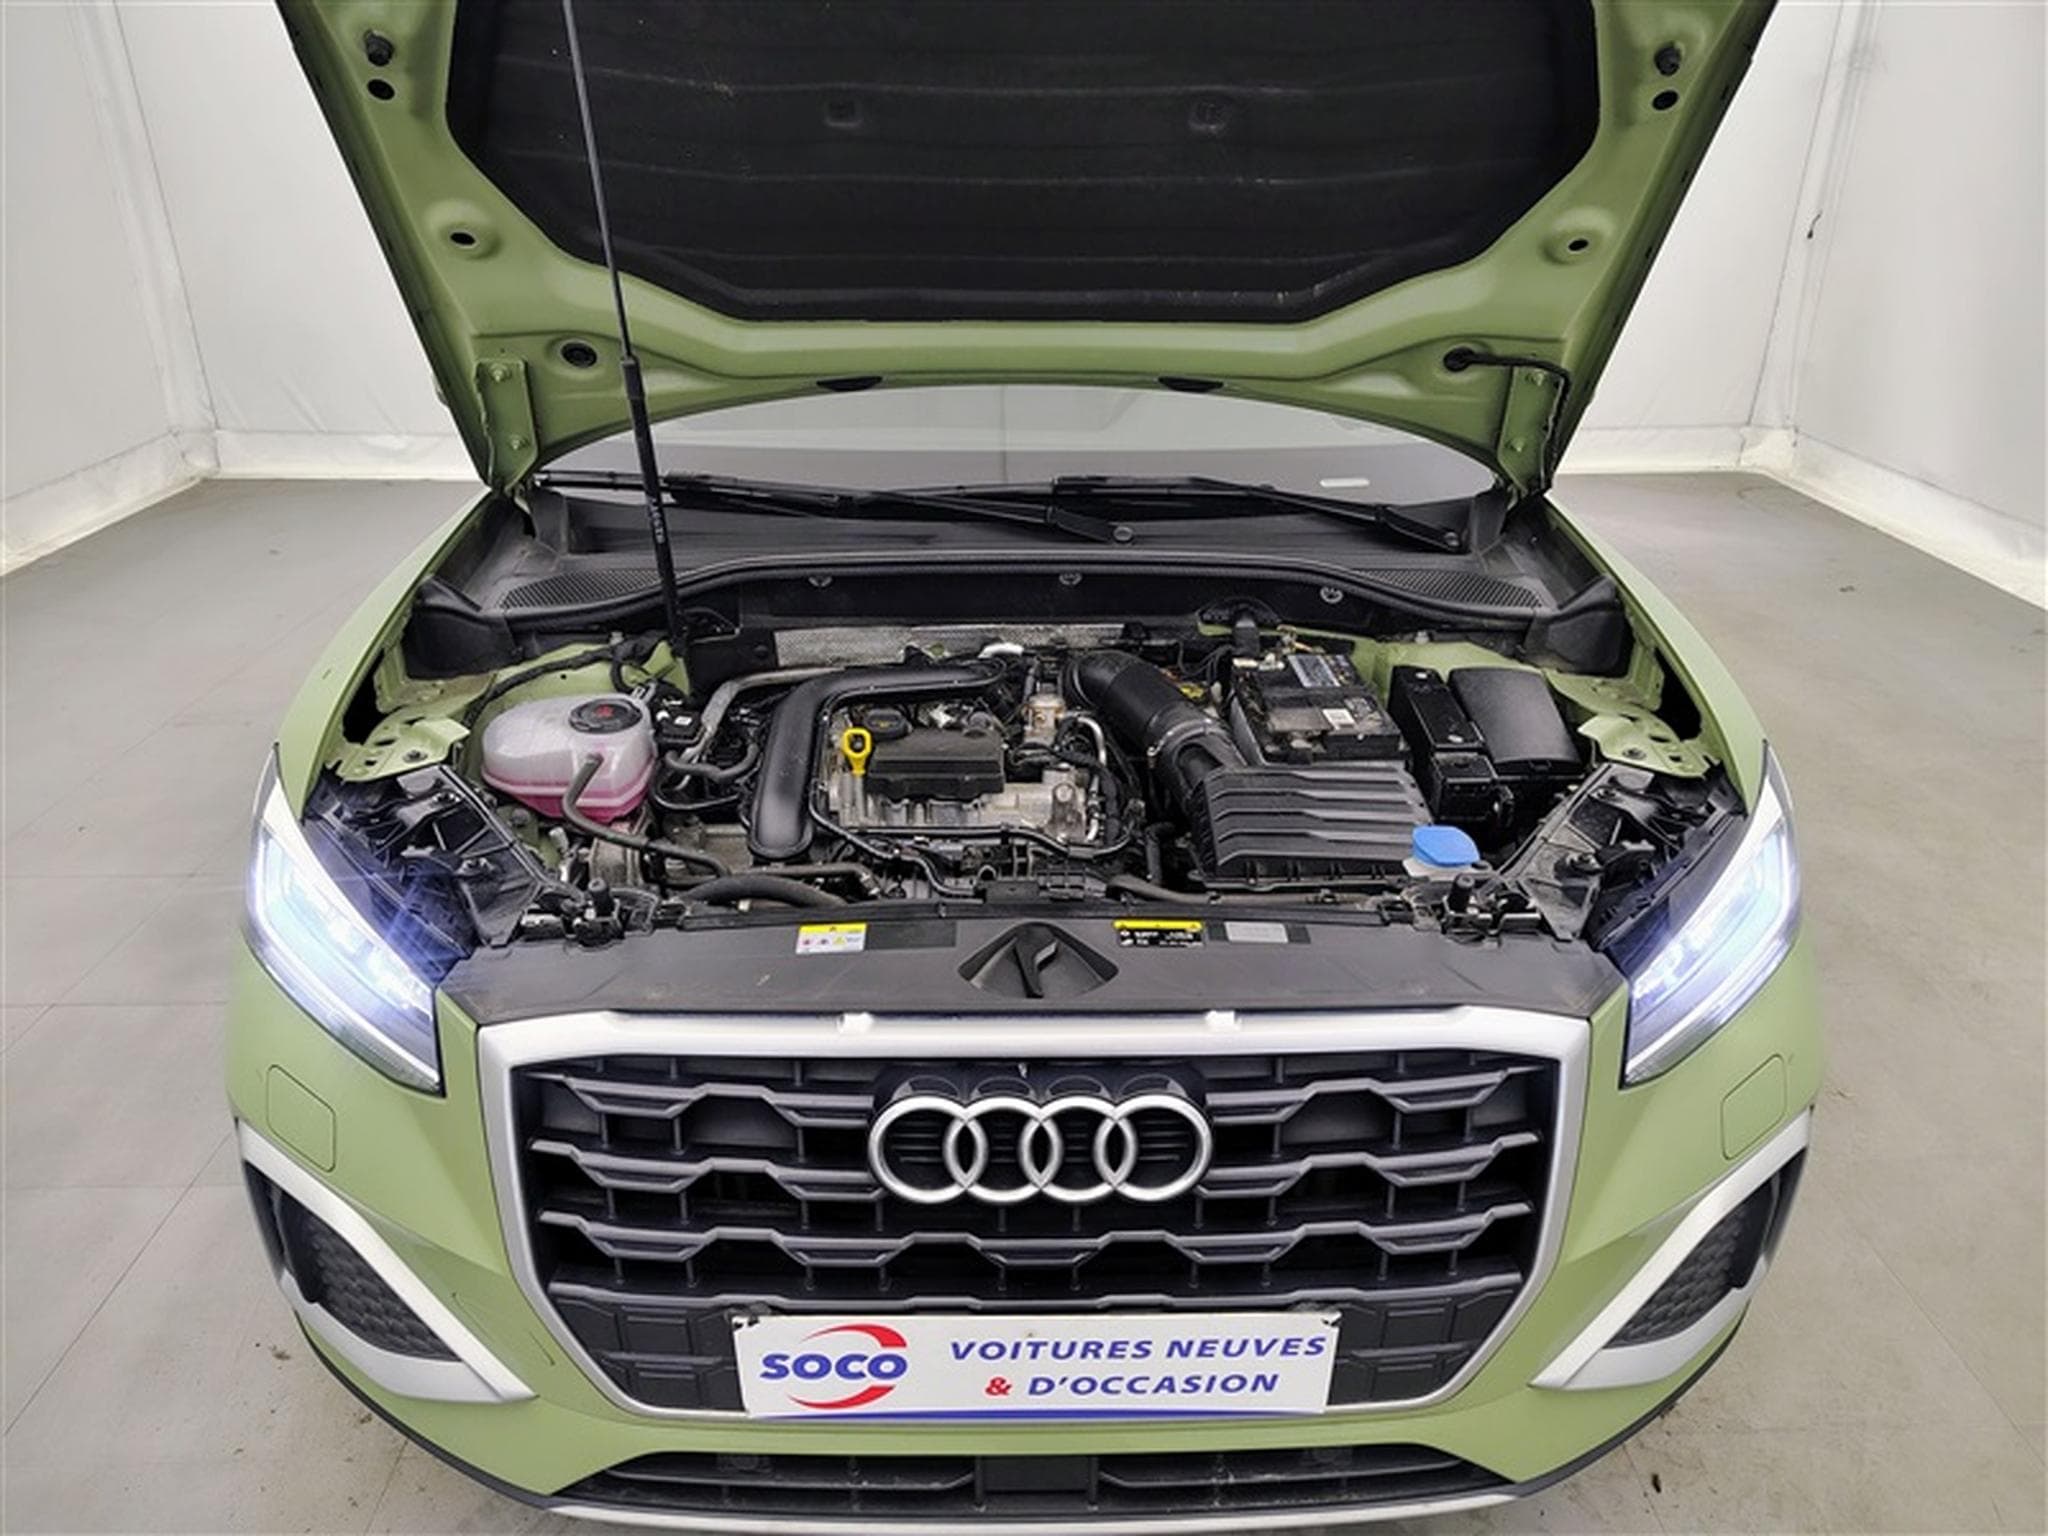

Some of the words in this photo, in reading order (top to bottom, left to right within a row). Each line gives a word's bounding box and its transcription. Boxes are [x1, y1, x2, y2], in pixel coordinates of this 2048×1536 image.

[951, 1339, 1153, 1361] VOITURES
[1166, 1335, 1326, 1359] NEUVES
[760, 1352, 909, 1381] SOCO
[985, 1376, 1011, 1396] &
[1027, 1373, 1278, 1396] D'OCCASION
